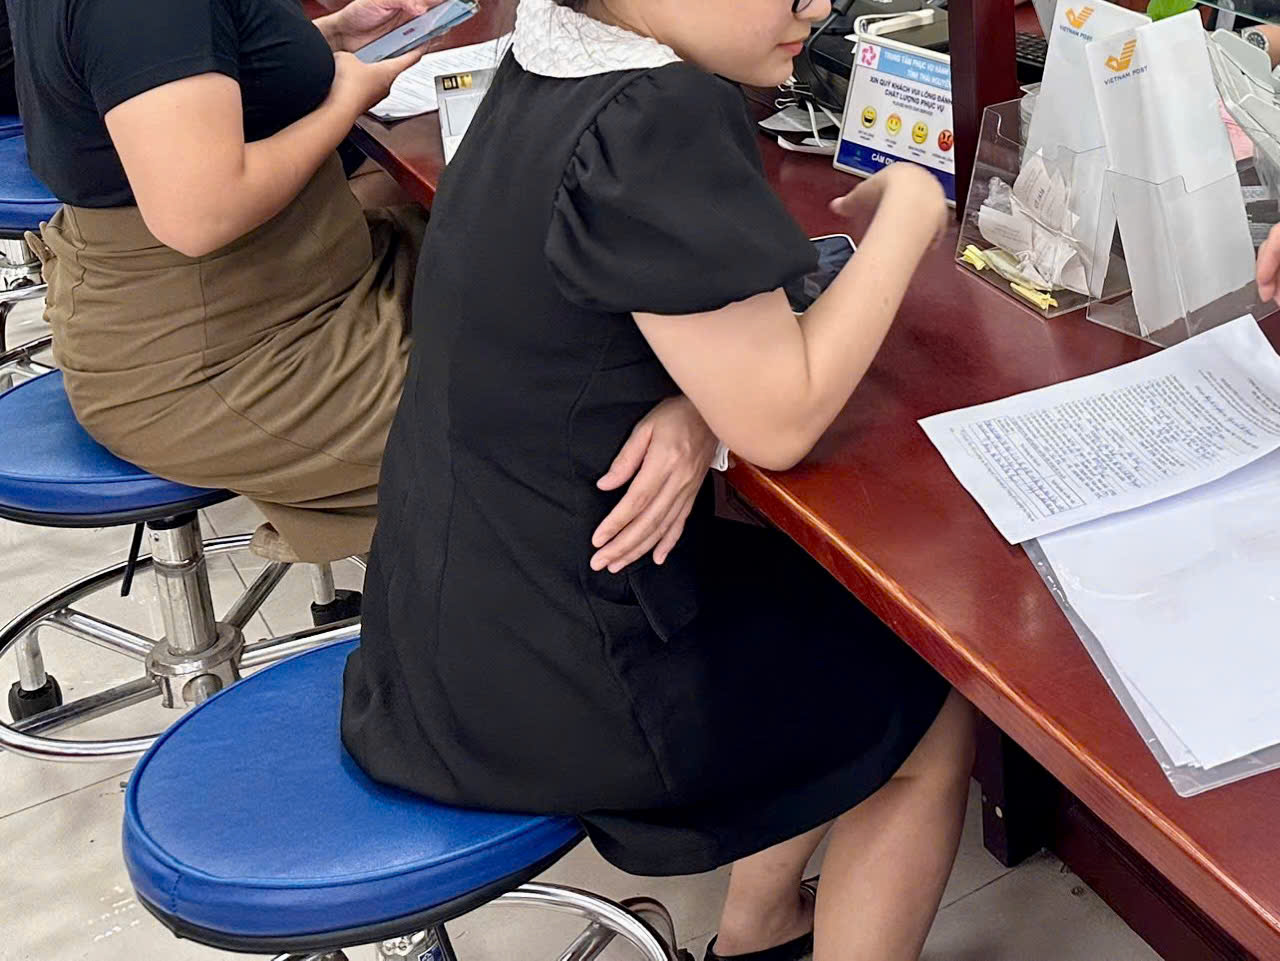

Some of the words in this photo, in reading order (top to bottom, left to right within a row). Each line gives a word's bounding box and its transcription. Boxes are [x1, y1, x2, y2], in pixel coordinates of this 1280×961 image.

[1080, 33, 1093, 41] POST
[1104, 72, 1130, 85] VIETNAM
[1132, 65, 1148, 75] POST
